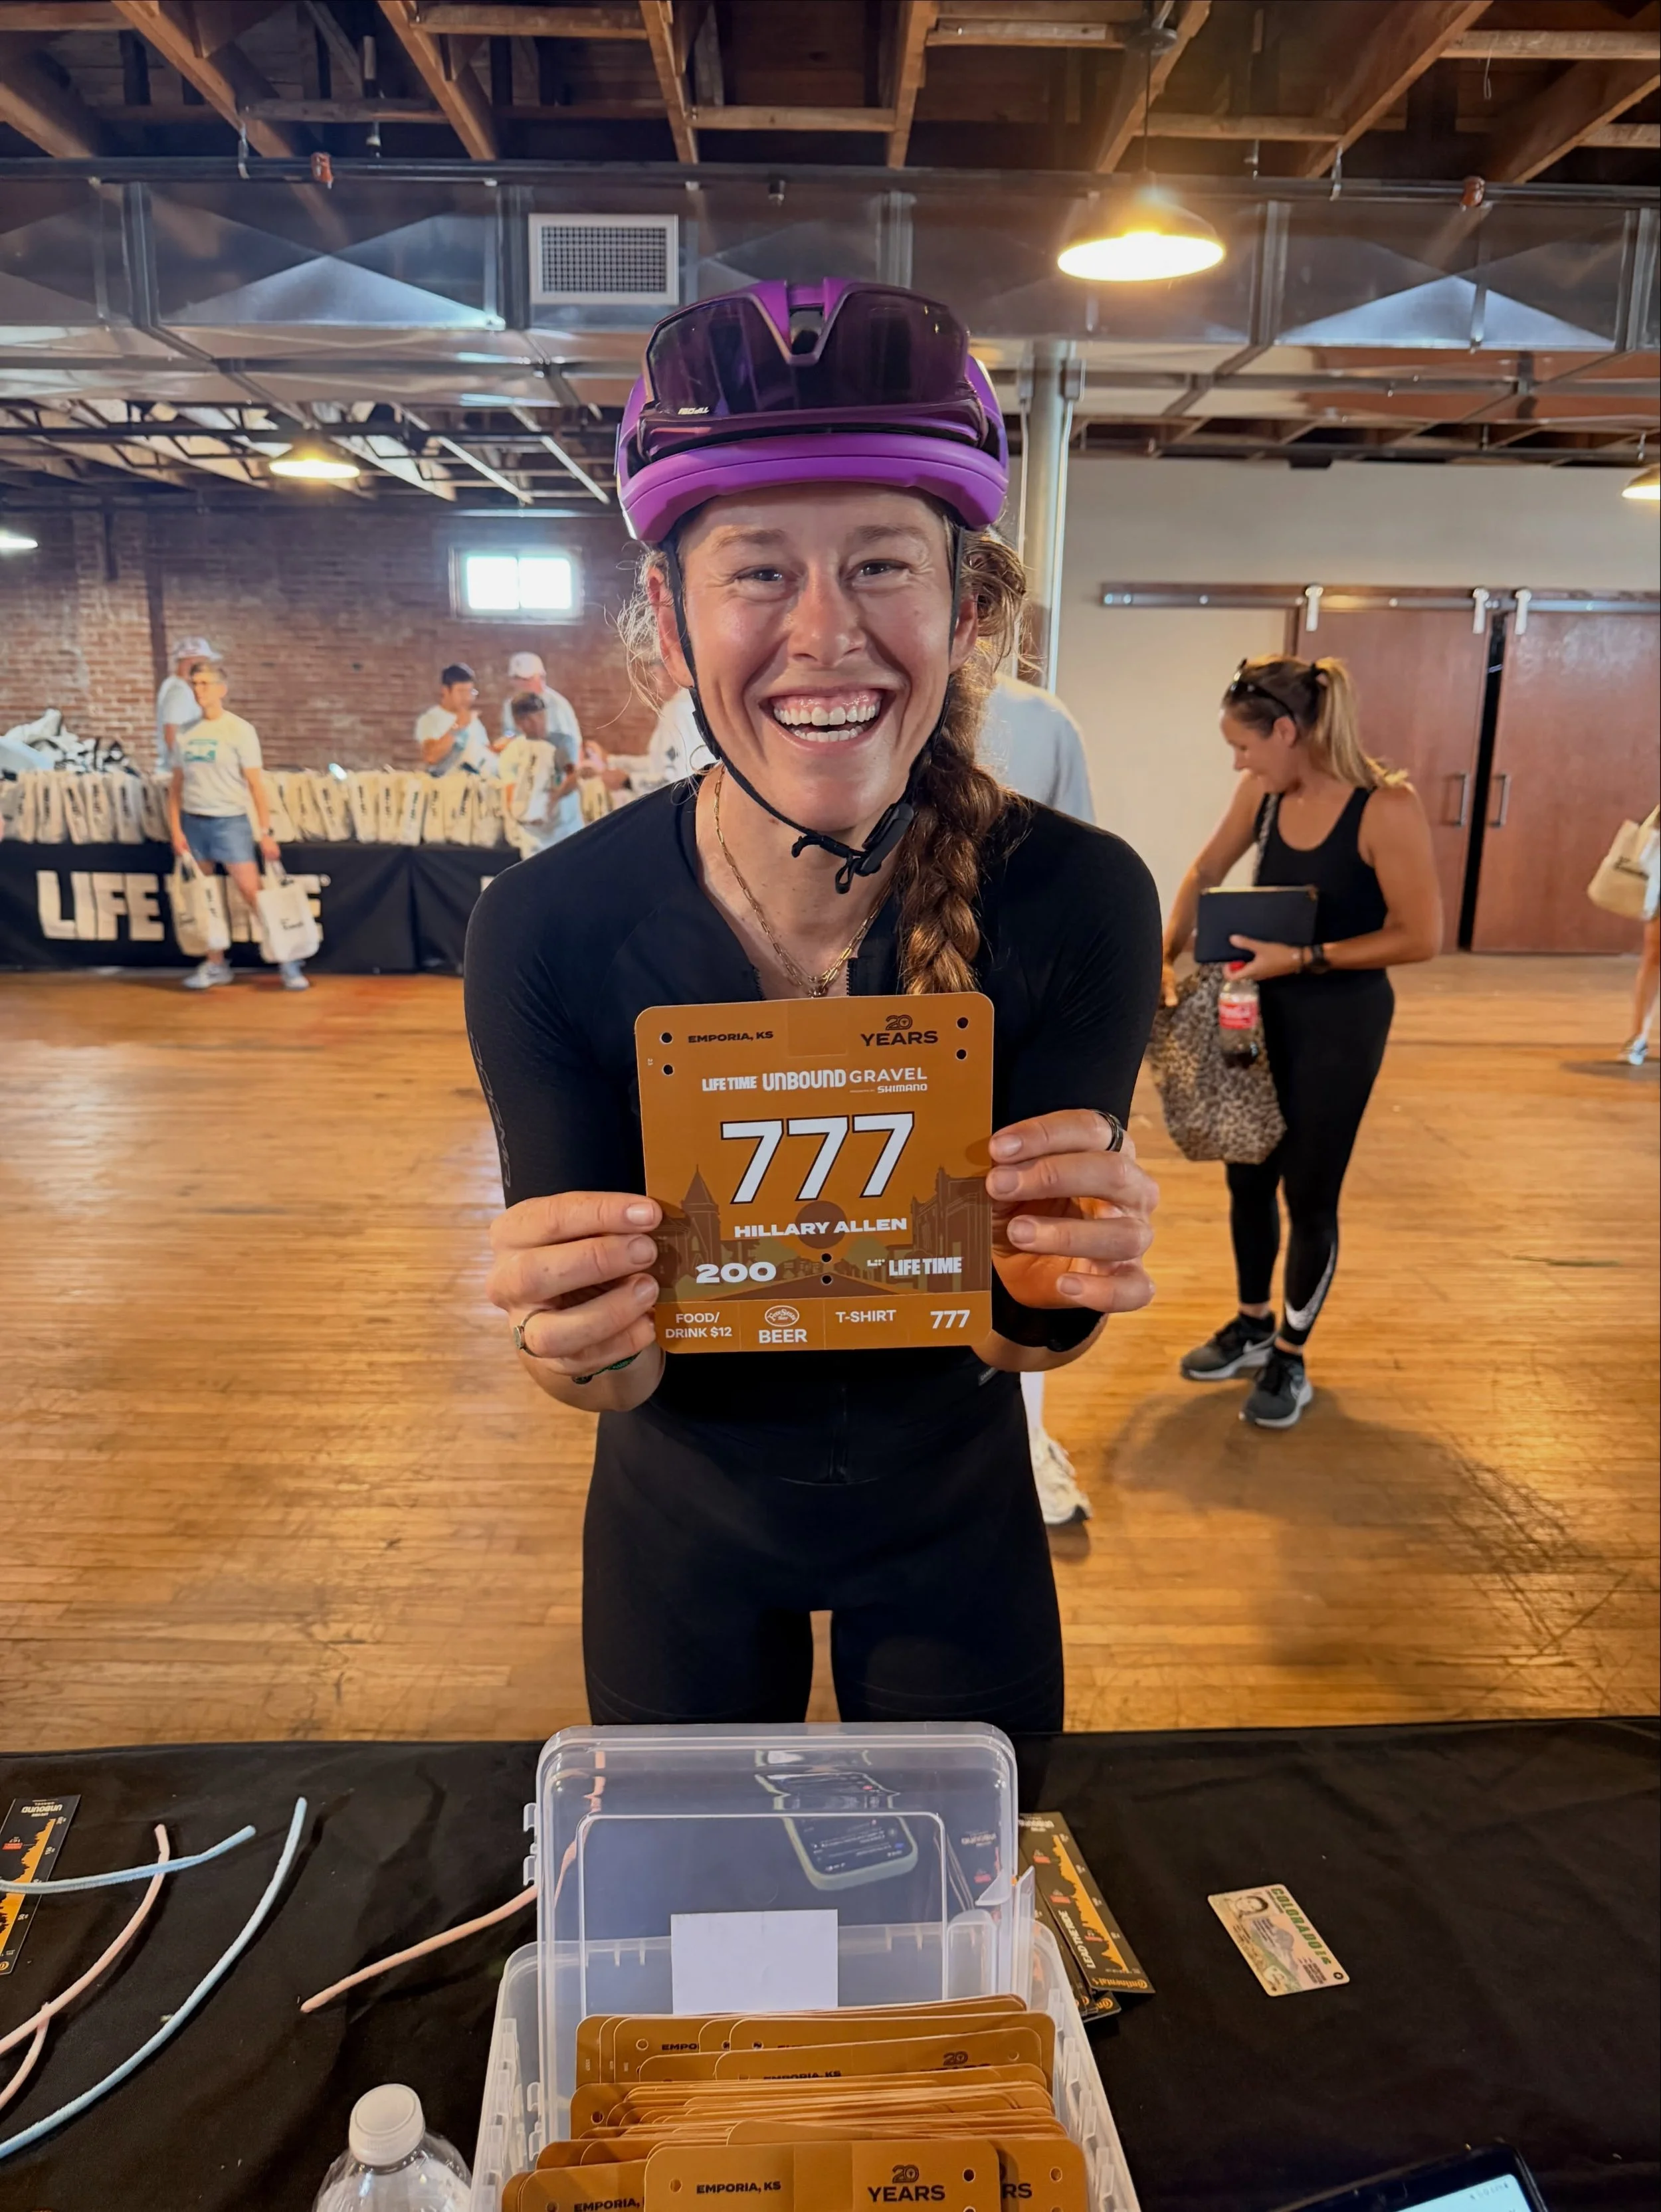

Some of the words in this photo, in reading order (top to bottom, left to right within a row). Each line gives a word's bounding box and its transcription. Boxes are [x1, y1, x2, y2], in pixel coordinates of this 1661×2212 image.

[37, 870, 164, 941] LIFE
[885, 1014, 913, 1030] 20
[688, 1032, 753, 1043] EMPORIA,
[756, 1031, 773, 1040] KS
[860, 1030, 939, 1046] YEARS
[762, 1069, 846, 1091] UNBOUND
[849, 1067, 928, 1083] GRAVEL
[877, 1083, 928, 1093] SHIMANO
[720, 1111, 915, 1204] 777
[734, 1222, 830, 1238] HILLARY
[833, 1218, 907, 1234] ALLEN
[696, 1261, 777, 1283] 200
[888, 1259, 921, 1276] LIFE
[922, 1257, 962, 1274] TIME
[676, 1311, 720, 1323] FOOD/
[835, 1309, 896, 1323] T-SHIRT
[930, 1309, 971, 1329] 777
[666, 1327, 708, 1338] DRINK
[710, 1327, 732, 1338] $12
[759, 1329, 808, 1343] BEER
[1270, 1889, 1322, 1948] COLORADO
[943, 2051, 969, 2067] 20
[892, 2164, 920, 2183] 20
[697, 2181, 762, 2194] EMPORIA,
[763, 2181, 781, 2191] KS
[867, 2185, 946, 2202] YEARS
[573, 2197, 640, 2212] EMPORIA,
